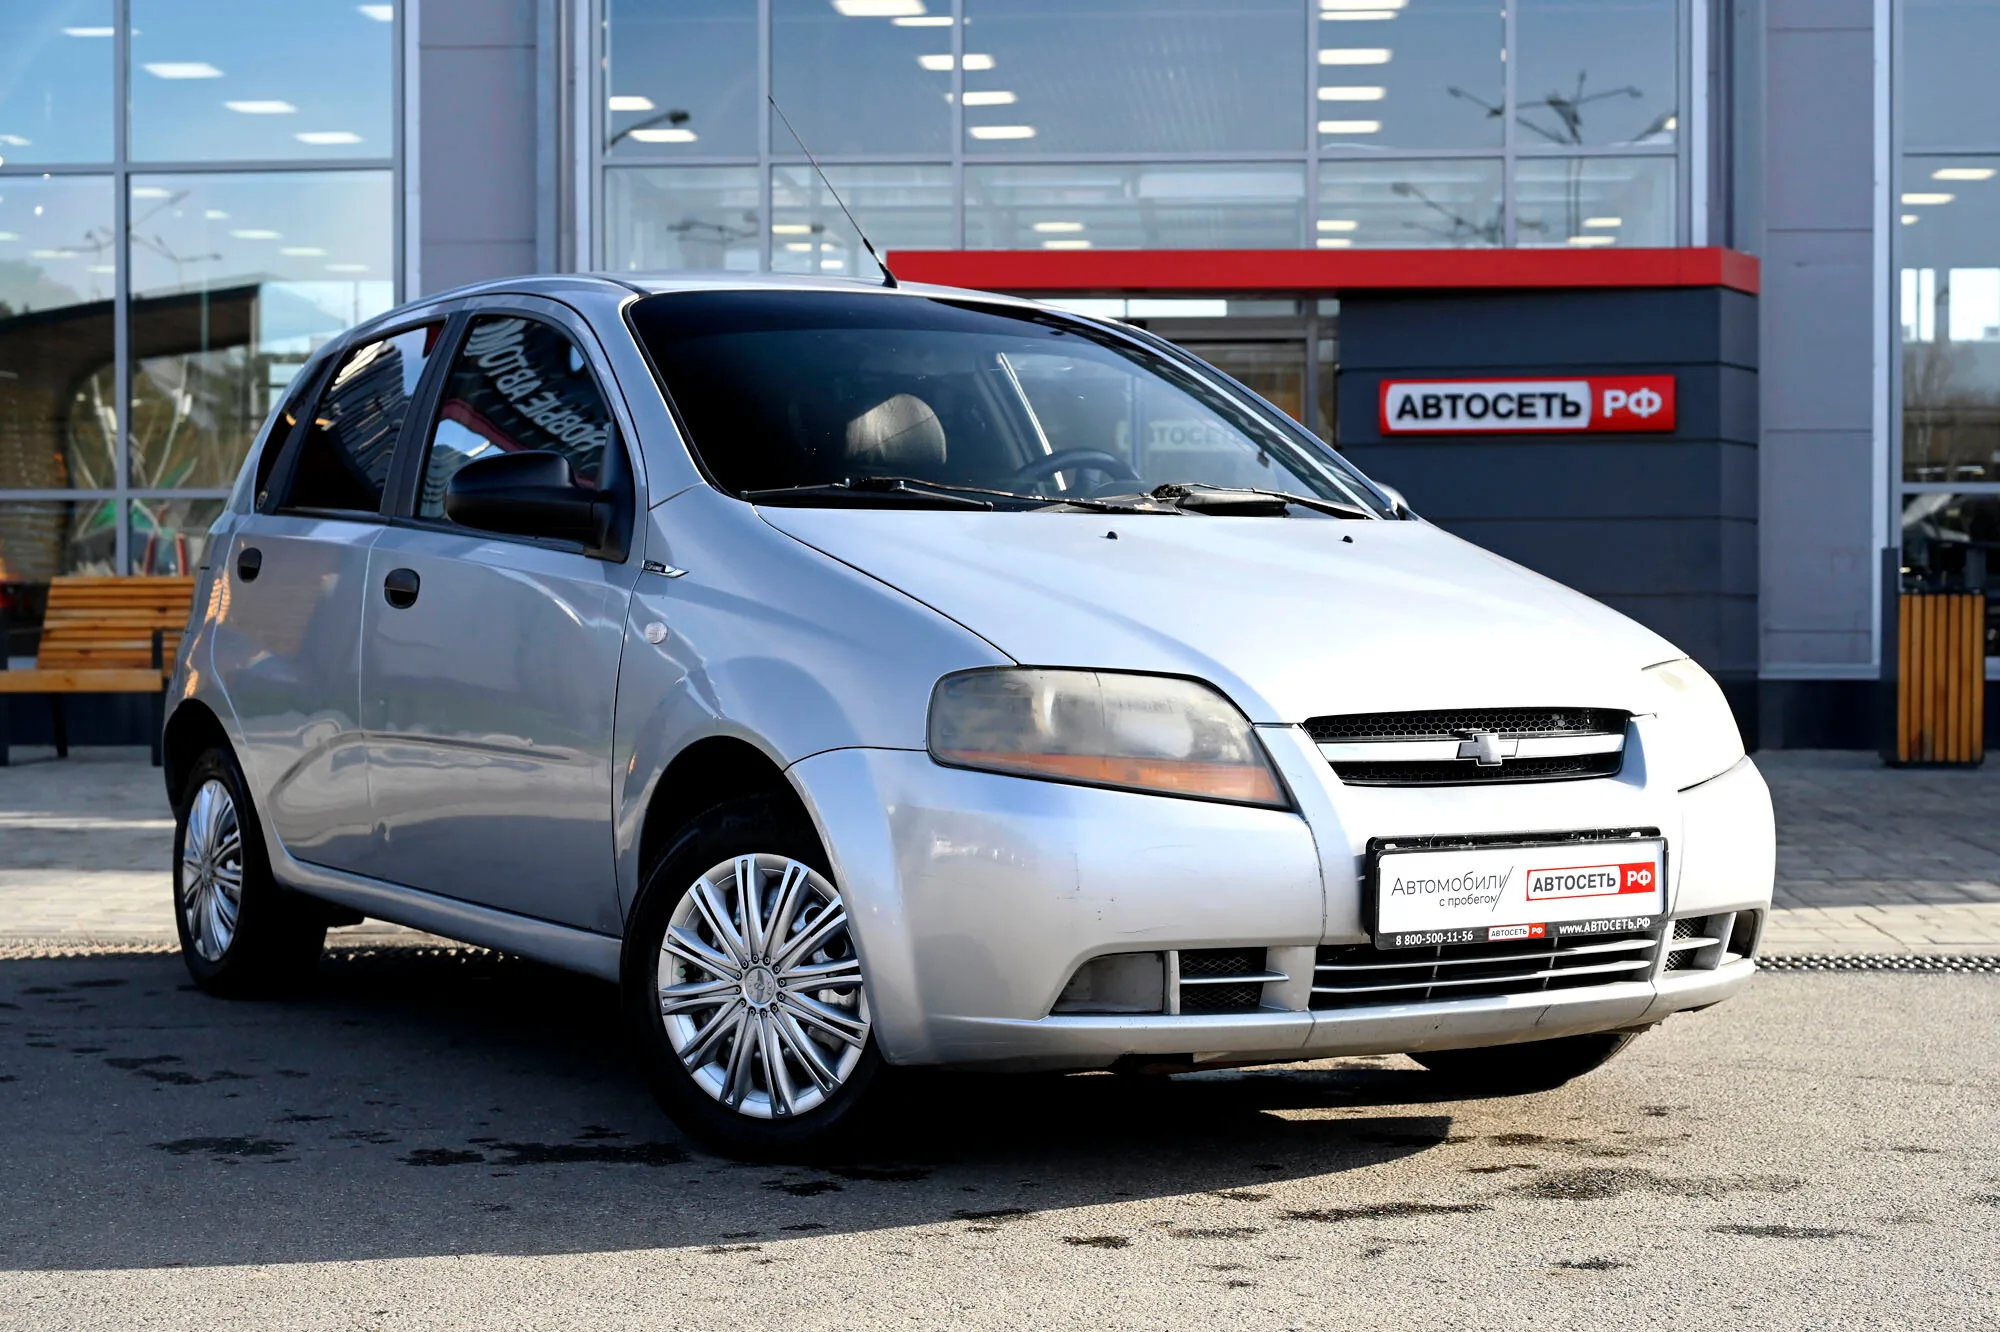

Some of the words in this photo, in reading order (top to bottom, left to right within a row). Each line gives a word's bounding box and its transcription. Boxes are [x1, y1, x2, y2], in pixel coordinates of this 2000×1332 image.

[1397, 393, 1582, 420] АВТОСЕТЬ
[1603, 388, 1662, 418] РФ
[1533, 873, 1616, 892] АВТОСЕТЬ
[1627, 869, 1652, 886] РФ
[1439, 898, 1445, 907] с
[1491, 928, 1528, 937] АВТОСЕТЬ
[1531, 927, 1543, 935] РФ
[1559, 917, 1651, 935] www.АВТОСЕТЬ.РФ
[1395, 935, 1402, 946] 8
[1404, 930, 1474, 945] 800-500-11-56
